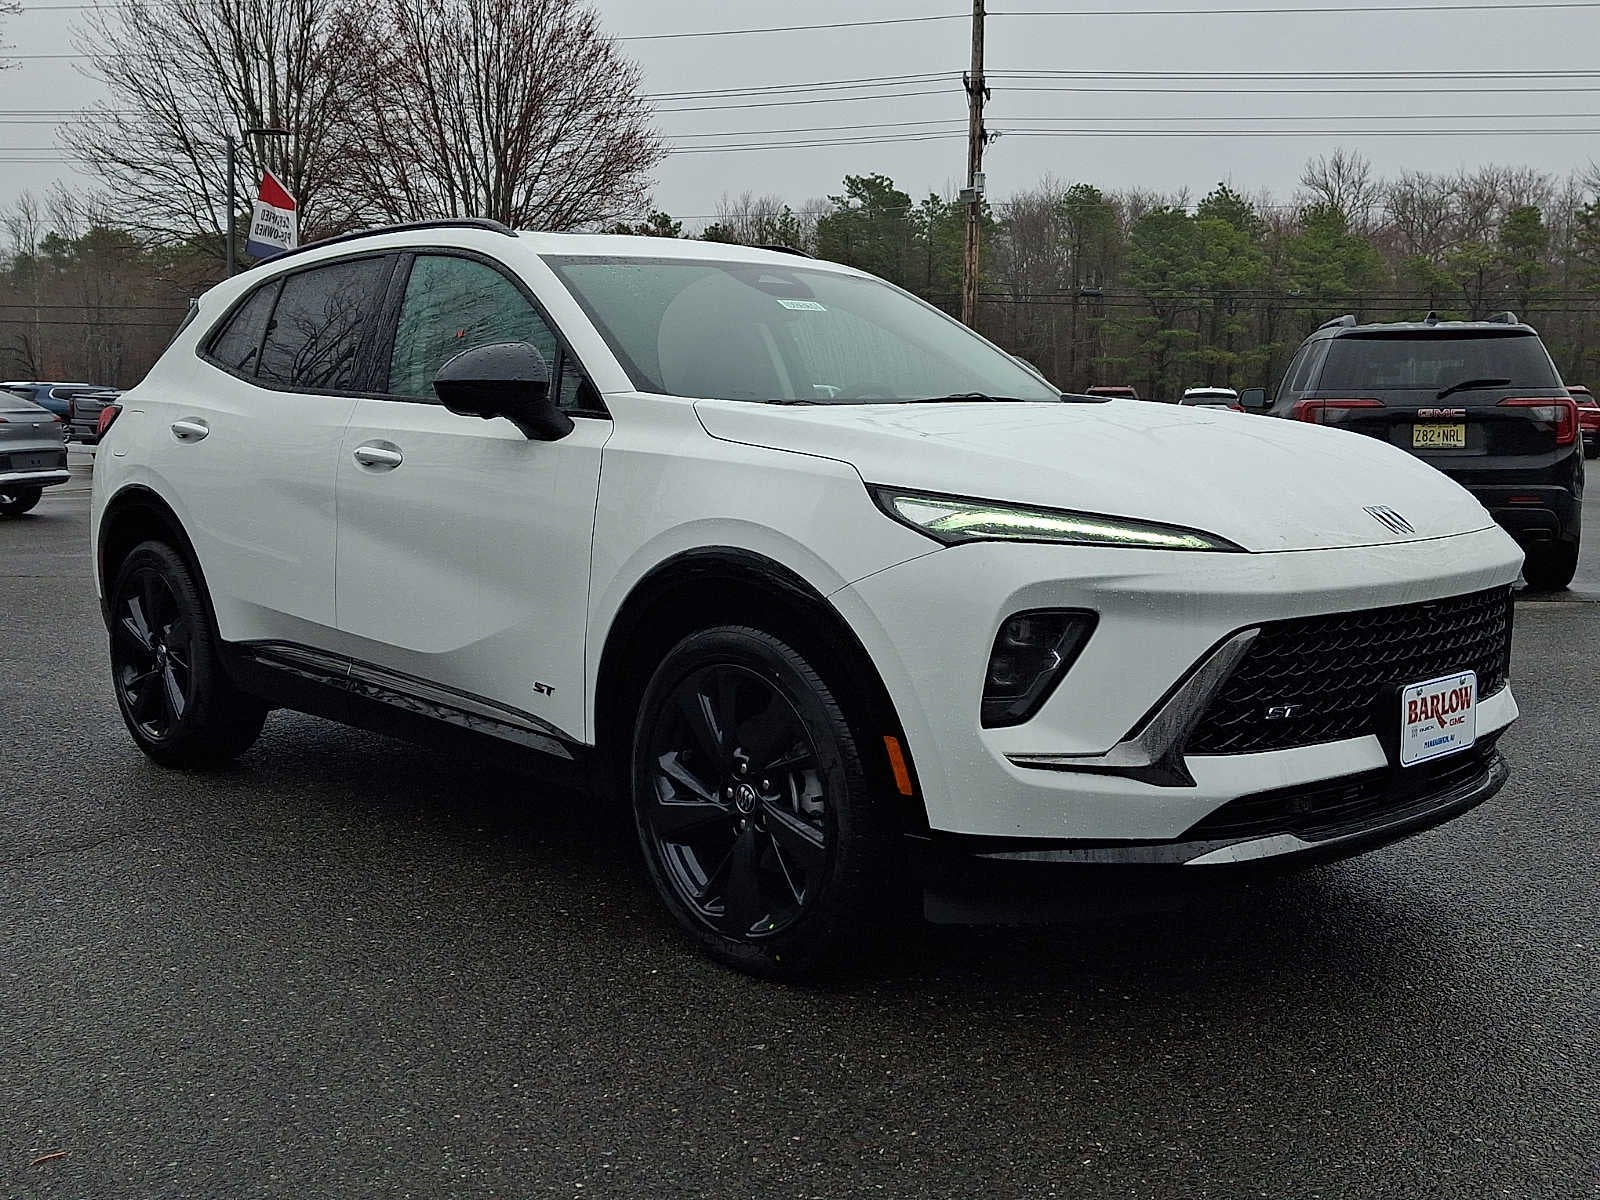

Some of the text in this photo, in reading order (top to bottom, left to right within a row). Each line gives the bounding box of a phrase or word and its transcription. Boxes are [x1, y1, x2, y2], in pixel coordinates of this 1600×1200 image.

[1417, 408, 1466, 418] GMC
[533, 681, 556, 697] ST
[1265, 703, 1303, 720] ST
[1407, 685, 1473, 729] BARLOW
[1449, 715, 1465, 726] GMC
